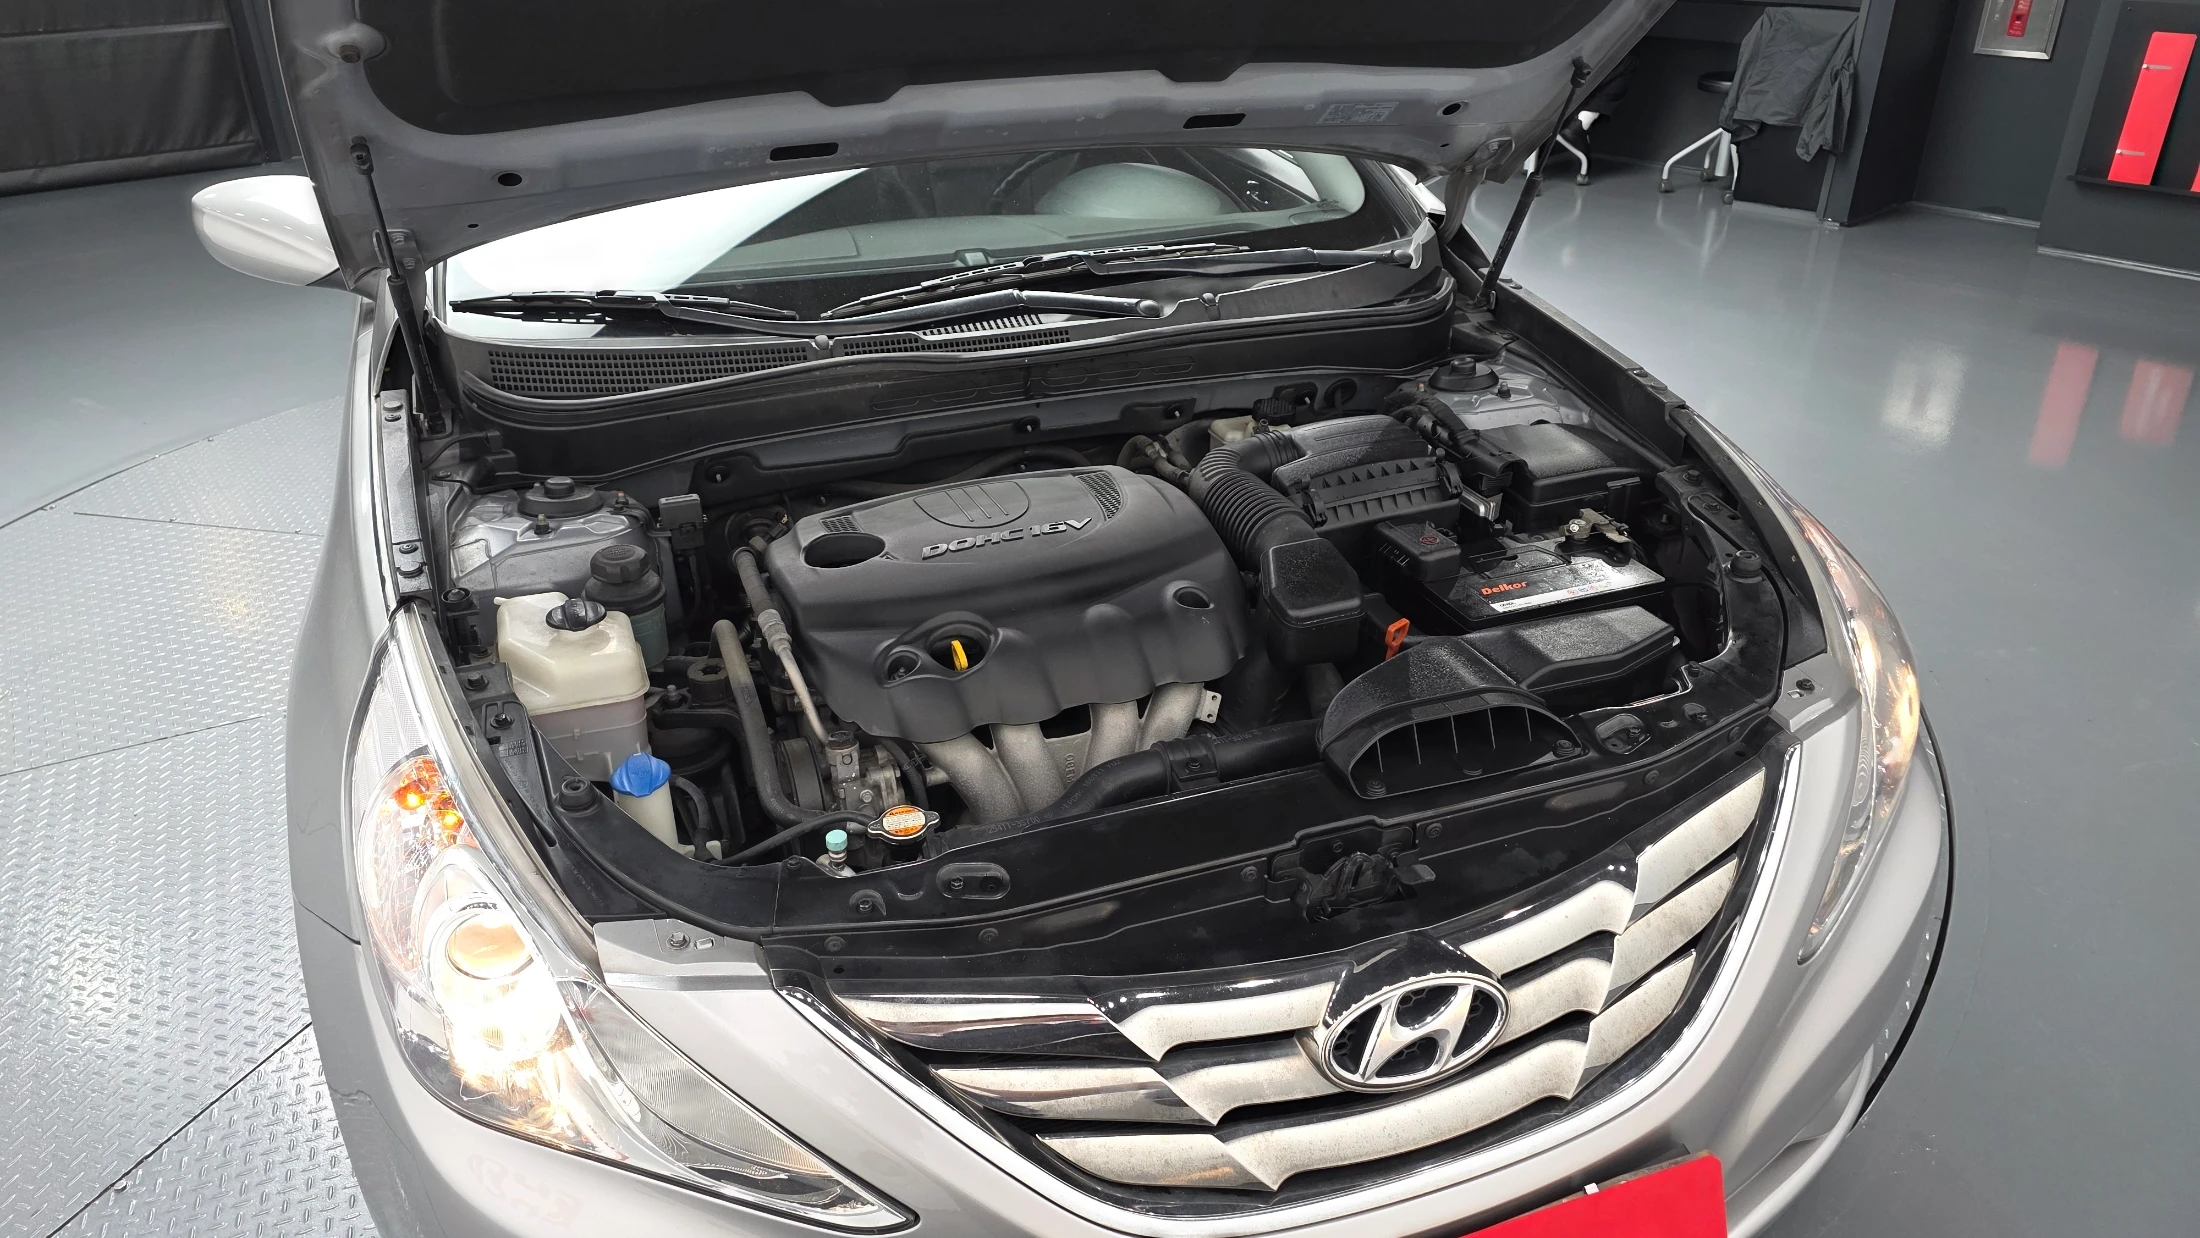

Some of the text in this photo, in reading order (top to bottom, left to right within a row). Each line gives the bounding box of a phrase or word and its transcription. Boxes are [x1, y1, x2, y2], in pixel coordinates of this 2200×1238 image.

[921, 517, 1093, 560] DOHC 16V
[1480, 581, 1528, 597] Delkor
